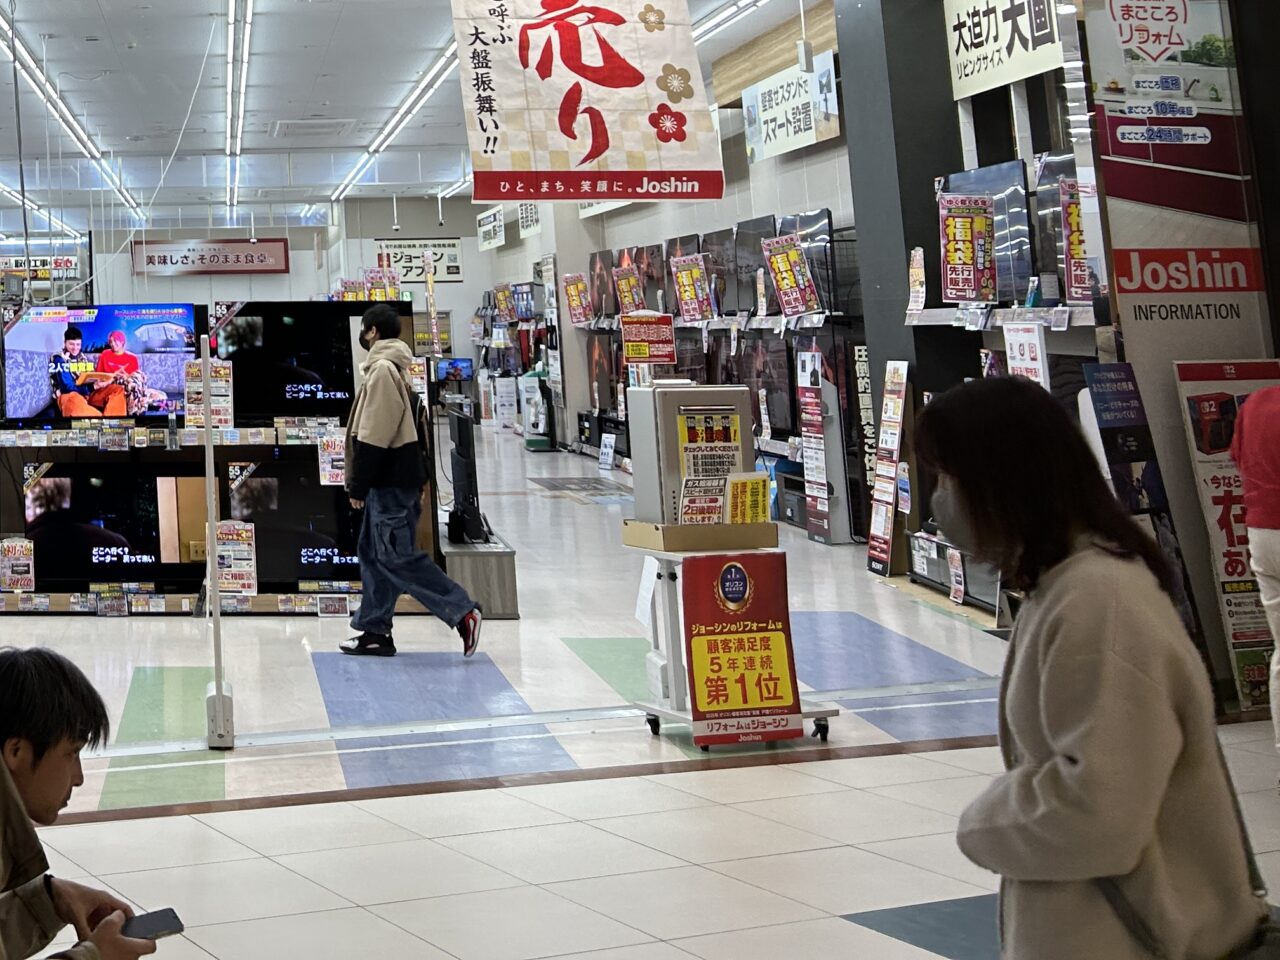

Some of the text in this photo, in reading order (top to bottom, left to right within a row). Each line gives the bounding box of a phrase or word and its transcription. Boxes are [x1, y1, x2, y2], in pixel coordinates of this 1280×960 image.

[1121, 4, 1178, 21] まごころ
[1119, 24, 1184, 45] リフォーム
[956, 47, 1005, 81] リビングサイズ
[1134, 76, 1182, 91] まごころ価格
[763, 102, 813, 145] スマート設置
[636, 176, 699, 193] Joshin
[945, 216, 973, 265] 福袋
[770, 253, 797, 290] 福袋
[949, 265, 972, 277] 先行
[1120, 250, 1248, 292] Joshin
[949, 277, 973, 288] 販売
[946, 288, 976, 298] セール
[216, 305, 228, 315] 55
[1132, 302, 1242, 321] INFORMATION
[24, 466, 35, 476] 55
[229, 466, 241, 475] 55
[691, 619, 783, 634] ジョーシンのリフォームは
[706, 636, 772, 654] 顧客満足度
[710, 655, 773, 673] 5年連続
[704, 672, 784, 705] 第1位
[706, 717, 789, 732] リフォームはジョーシン
